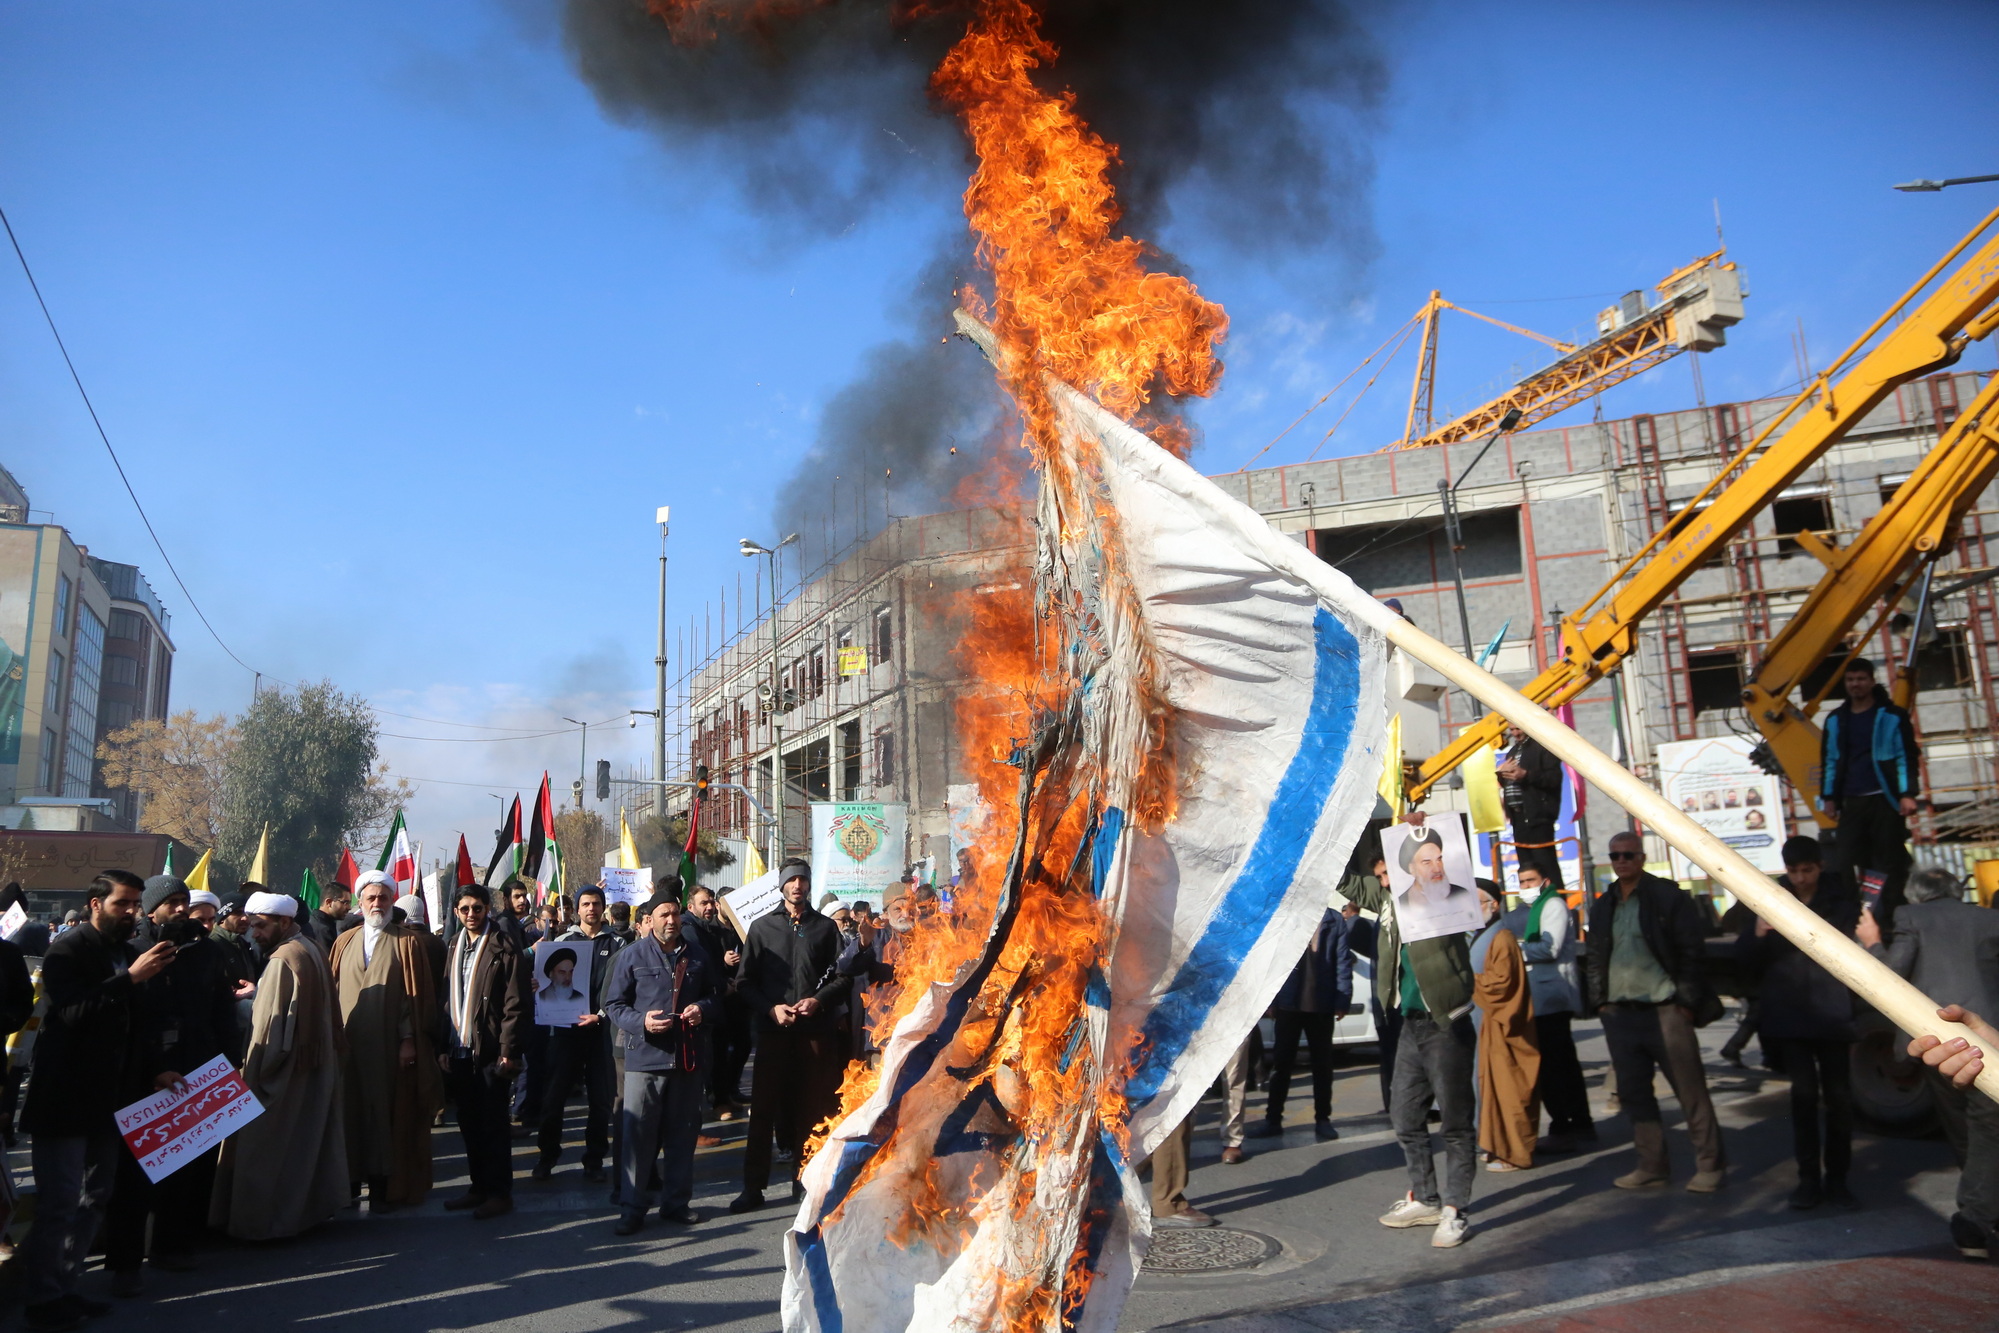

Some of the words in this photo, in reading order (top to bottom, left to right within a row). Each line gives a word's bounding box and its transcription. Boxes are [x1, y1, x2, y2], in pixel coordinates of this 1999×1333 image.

[65, 845, 139, 873] کتاب
[190, 1062, 229, 1091] DOWN
[156, 1086, 189, 1113] WITH
[121, 1109, 154, 1128] U.S.A
[145, 1160, 156, 1168] ما
[157, 1144, 184, 1165] آمریکا
[182, 1136, 193, 1145] را
[191, 1128, 203, 1140] زیر
[206, 1122, 214, 1131] پا
[213, 1113, 225, 1125] می
[228, 1095, 252, 1118] گذاریم
[134, 1124, 172, 1148] مرگ
